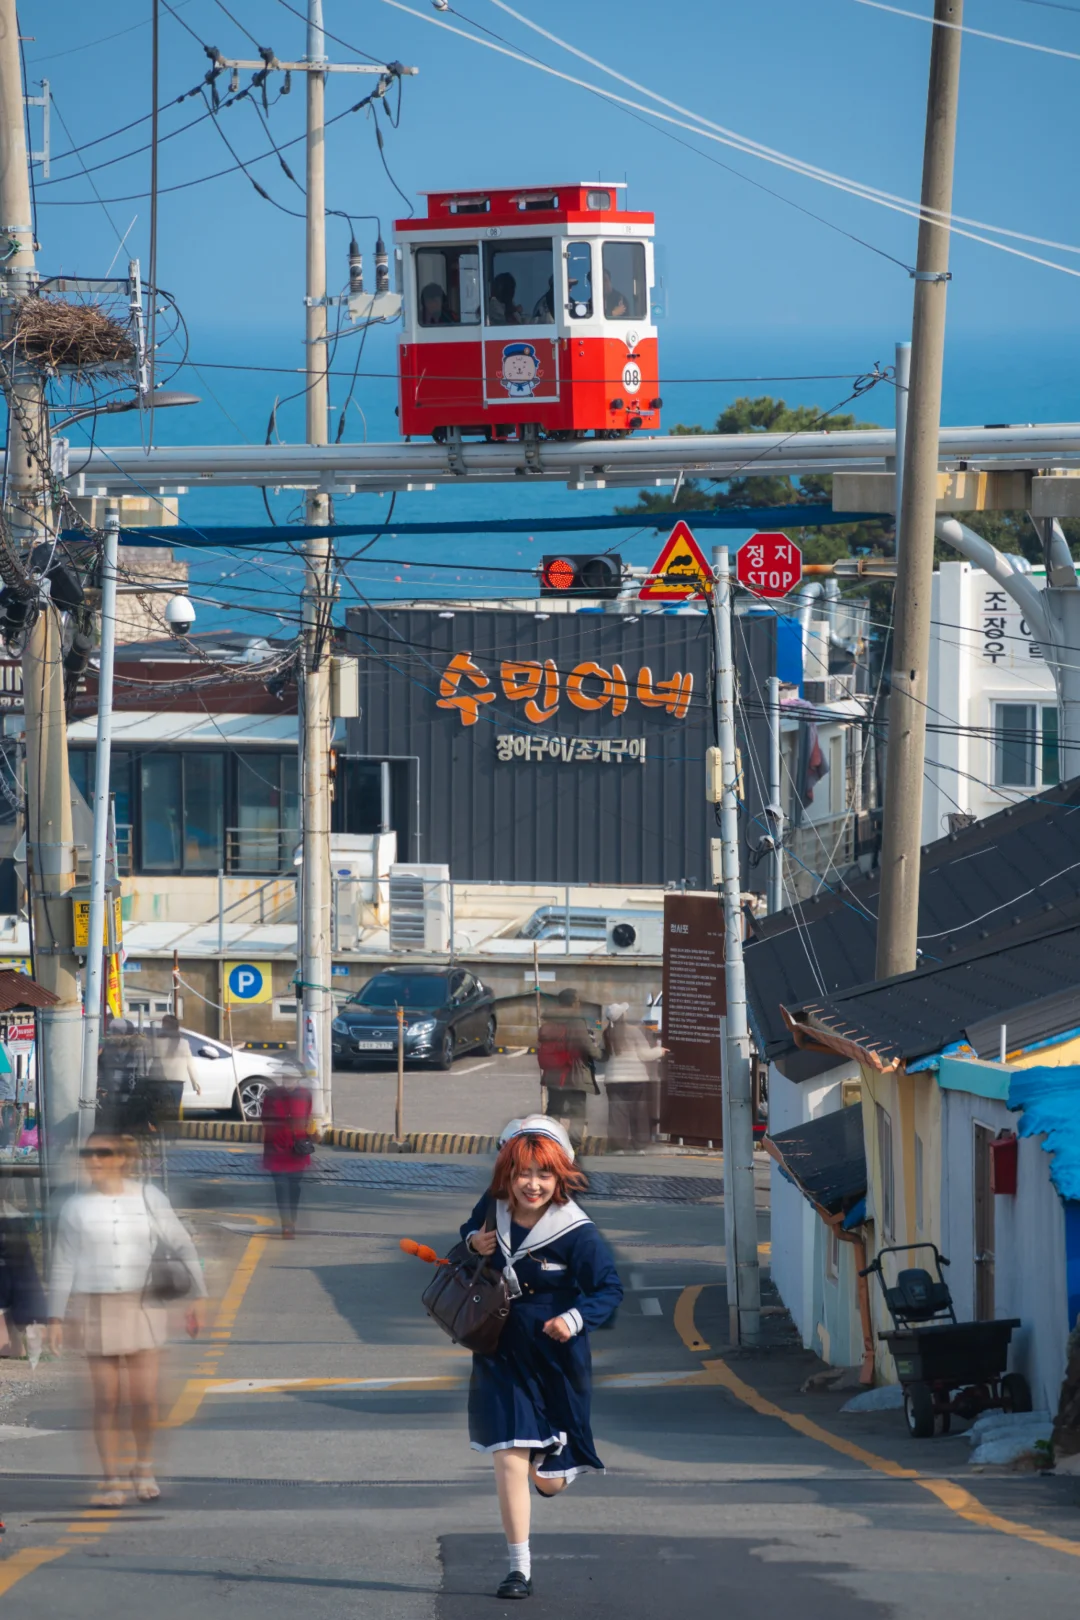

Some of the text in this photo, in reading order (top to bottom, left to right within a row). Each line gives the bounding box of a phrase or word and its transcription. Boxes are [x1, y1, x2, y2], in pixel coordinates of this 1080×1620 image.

[490, 228, 498, 236] 08
[624, 369, 639, 386] 08
[747, 571, 793, 589] STOP
[436, 652, 694, 727] 수민이네
[237, 971, 255, 993] P
